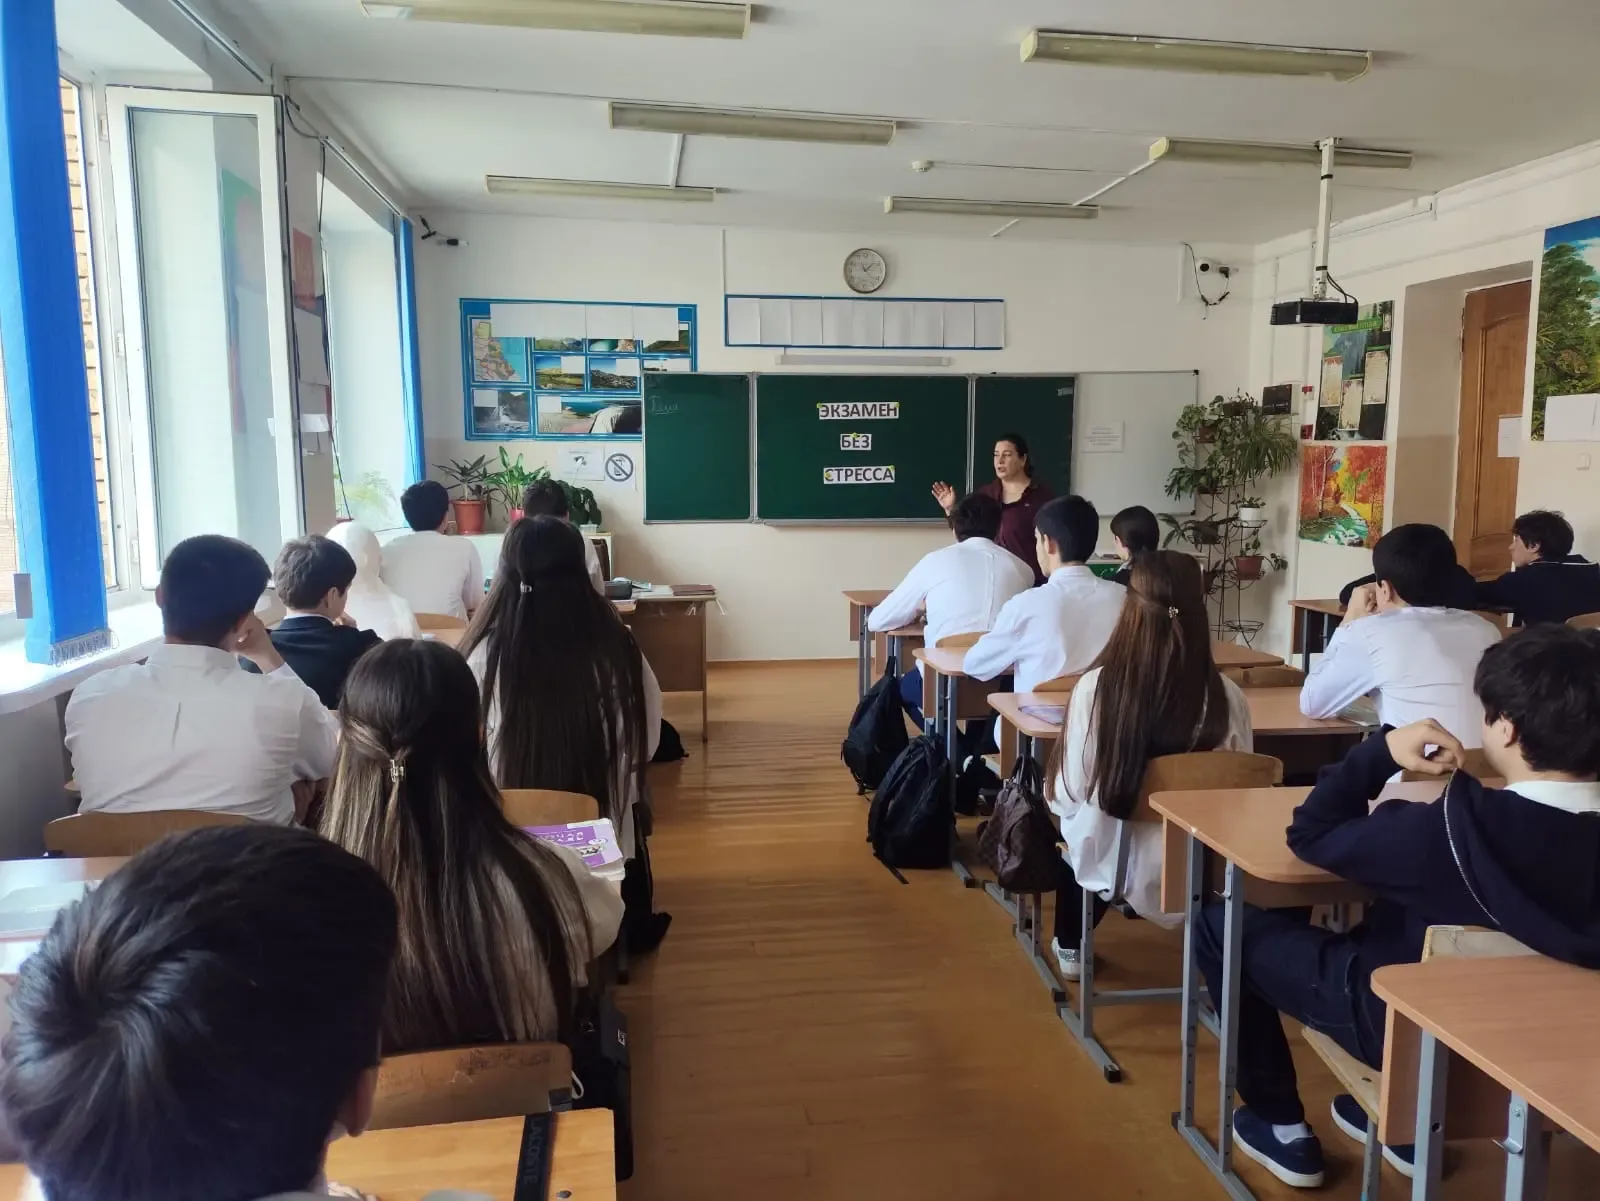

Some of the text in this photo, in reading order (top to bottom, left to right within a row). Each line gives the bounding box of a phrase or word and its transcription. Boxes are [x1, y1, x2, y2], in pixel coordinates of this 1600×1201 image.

[820, 403, 898, 418] ЭКЗАМЕН
[841, 434, 870, 449] БЕЗ
[824, 467, 894, 482] СТРЕССА
[524, 1117, 543, 1185] LACOSTE
